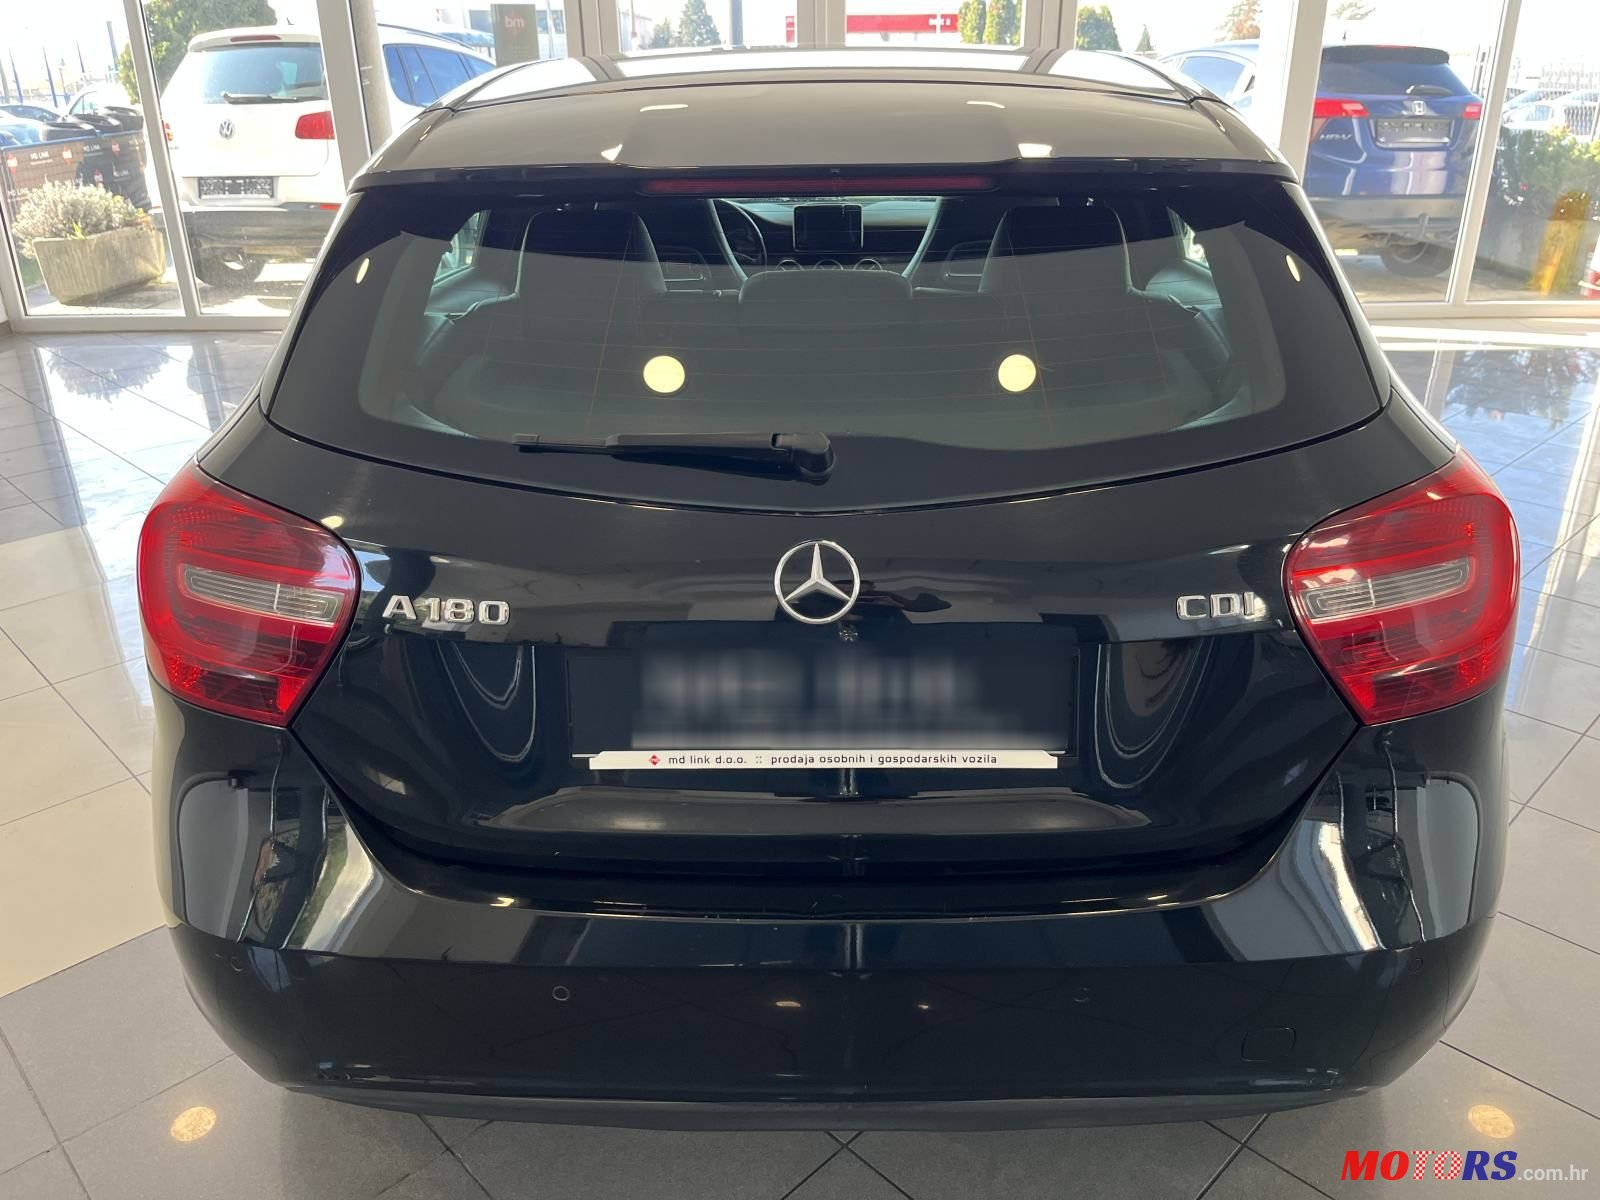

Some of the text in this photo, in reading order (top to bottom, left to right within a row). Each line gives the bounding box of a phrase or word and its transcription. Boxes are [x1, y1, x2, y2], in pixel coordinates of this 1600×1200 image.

[1176, 592, 1255, 620] CDI
[668, 755, 685, 764] md
[690, 755, 710, 764] link
[715, 755, 747, 764] d.o.o.
[771, 755, 815, 766] prodaja
[819, 754, 865, 763] osobnih
[878, 754, 957, 765] gospodarskih
[962, 754, 997, 763] vozila
